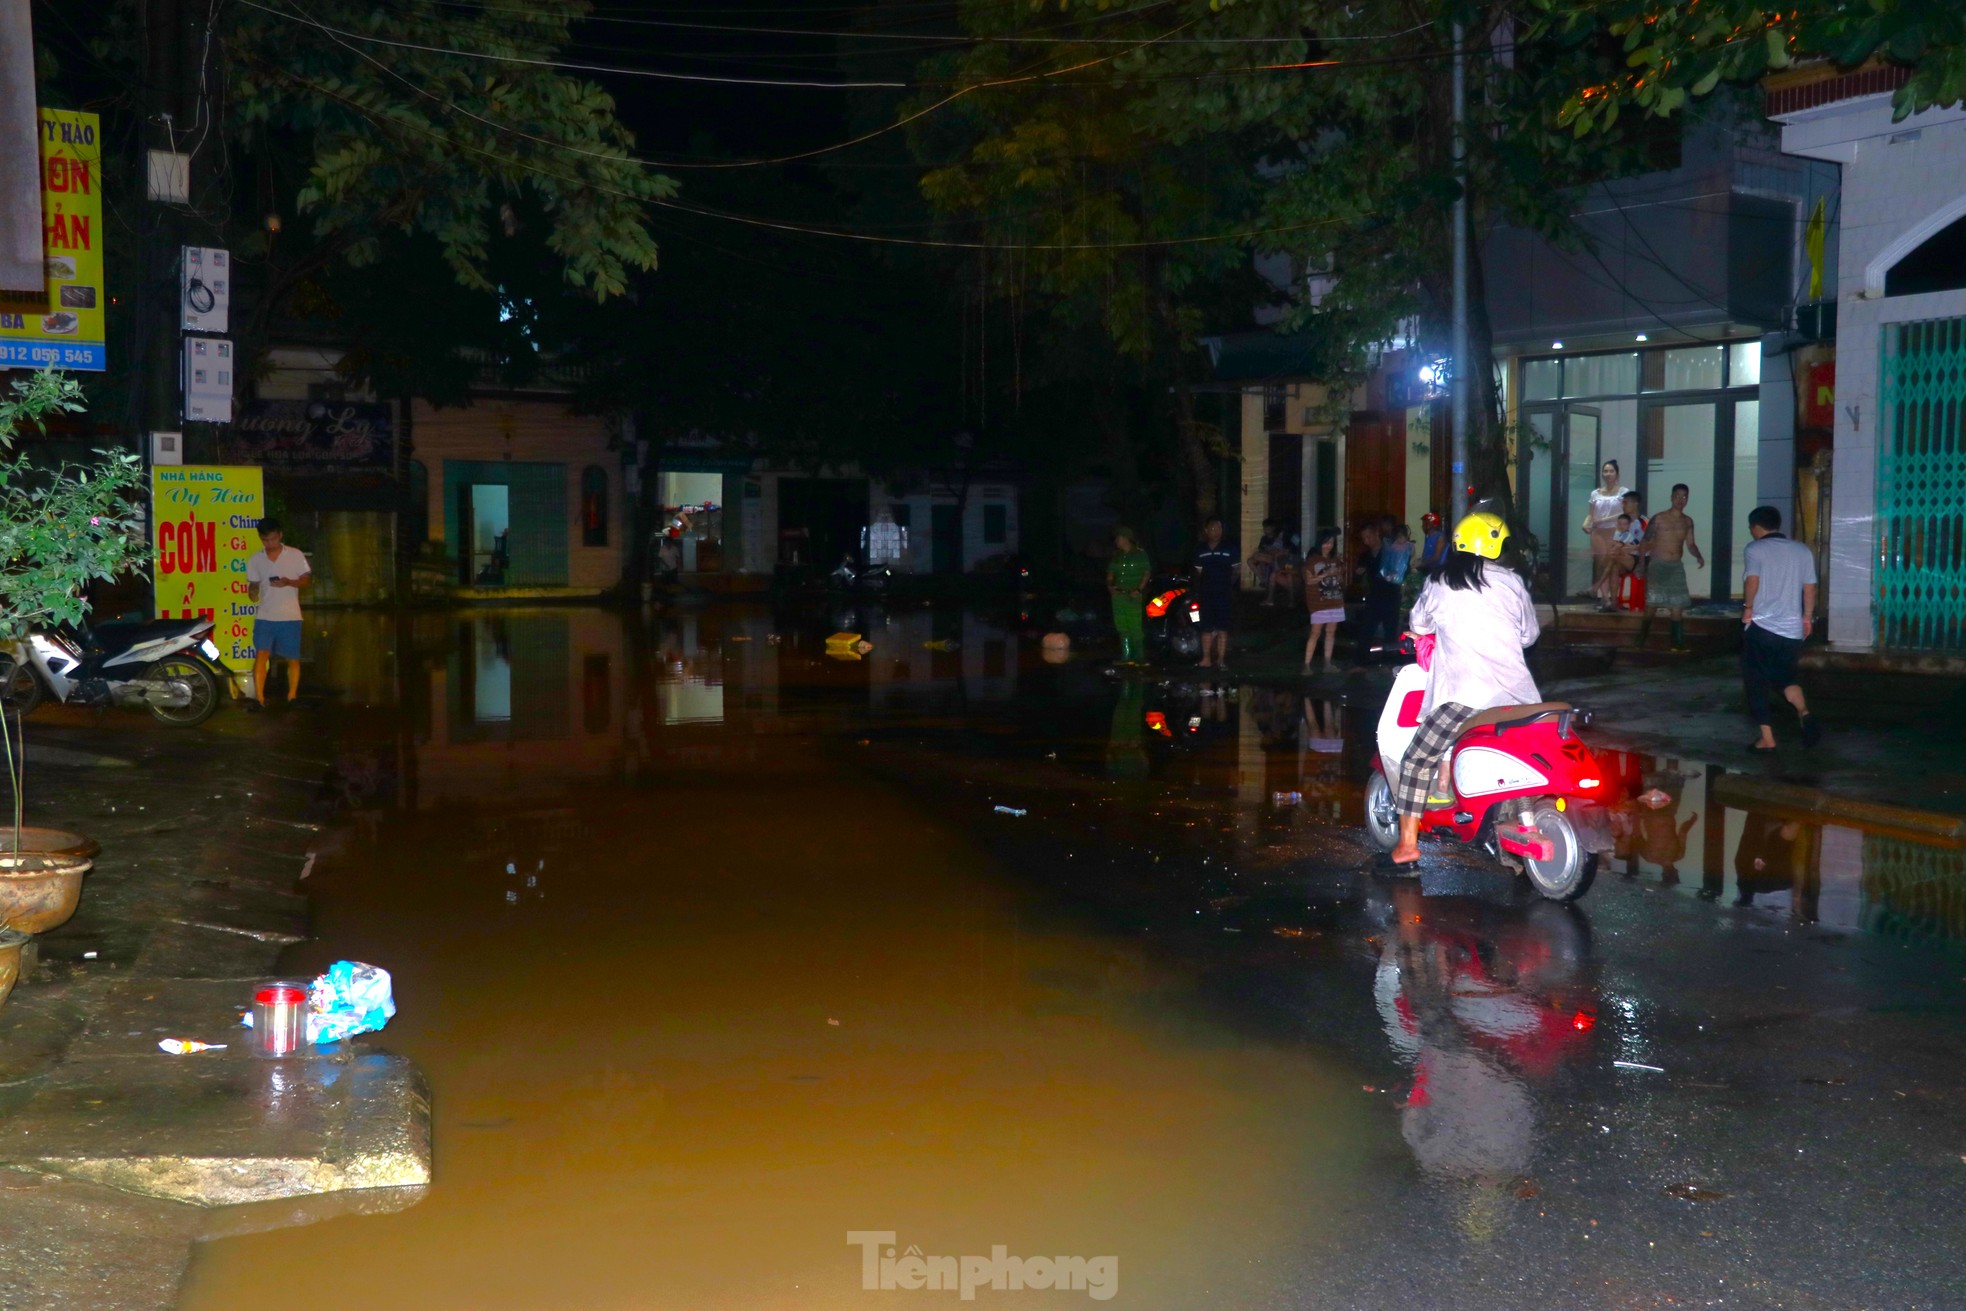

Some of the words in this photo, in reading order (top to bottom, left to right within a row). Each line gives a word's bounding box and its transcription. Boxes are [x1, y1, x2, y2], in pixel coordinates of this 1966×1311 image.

[61, 117, 94, 146] HÀO
[32, 348, 60, 361] 056
[65, 350, 93, 363] 545
[160, 470, 186, 481] NHÀ
[190, 470, 224, 482] HÀNG
[165, 487, 200, 506] Vy
[210, 487, 254, 503] Hào
[158, 510, 217, 574] CƠM
[230, 535, 247, 551] Gà
[231, 558, 247, 573] Cá
[231, 580, 249, 595] Cu
[231, 602, 259, 616] Lươ
[231, 617, 248, 638] Ốc
[232, 638, 257, 659] Ếch
